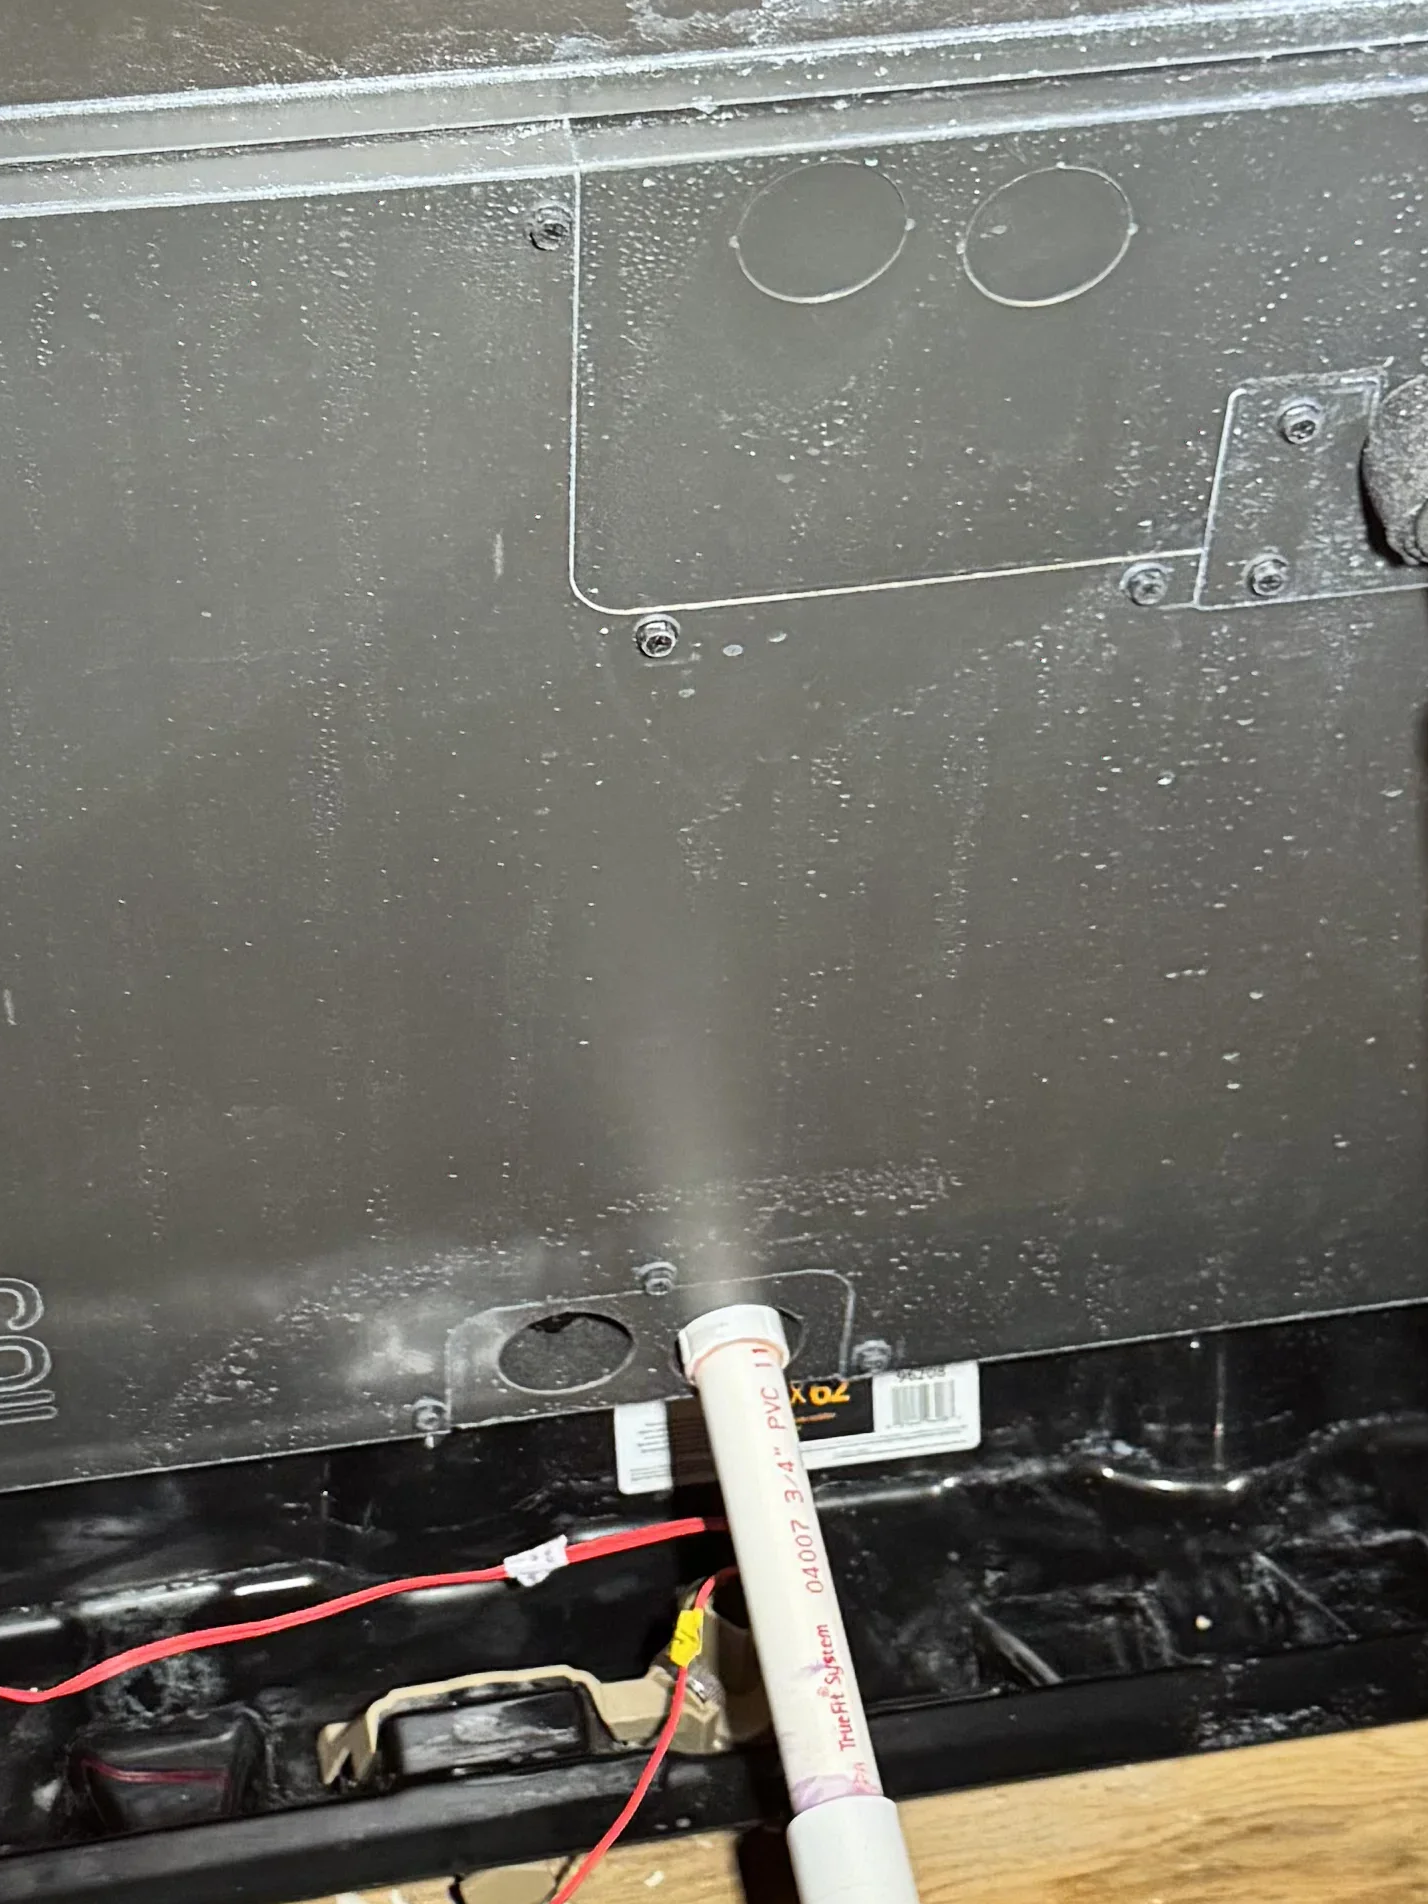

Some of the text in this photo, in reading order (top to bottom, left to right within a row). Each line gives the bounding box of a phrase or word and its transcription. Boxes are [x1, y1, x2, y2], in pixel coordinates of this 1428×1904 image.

[760, 1386, 786, 1431] PVC
[773, 1446, 805, 1504] 3/4"
[790, 1519, 824, 1594] 04007
[816, 1624, 845, 1685] System
